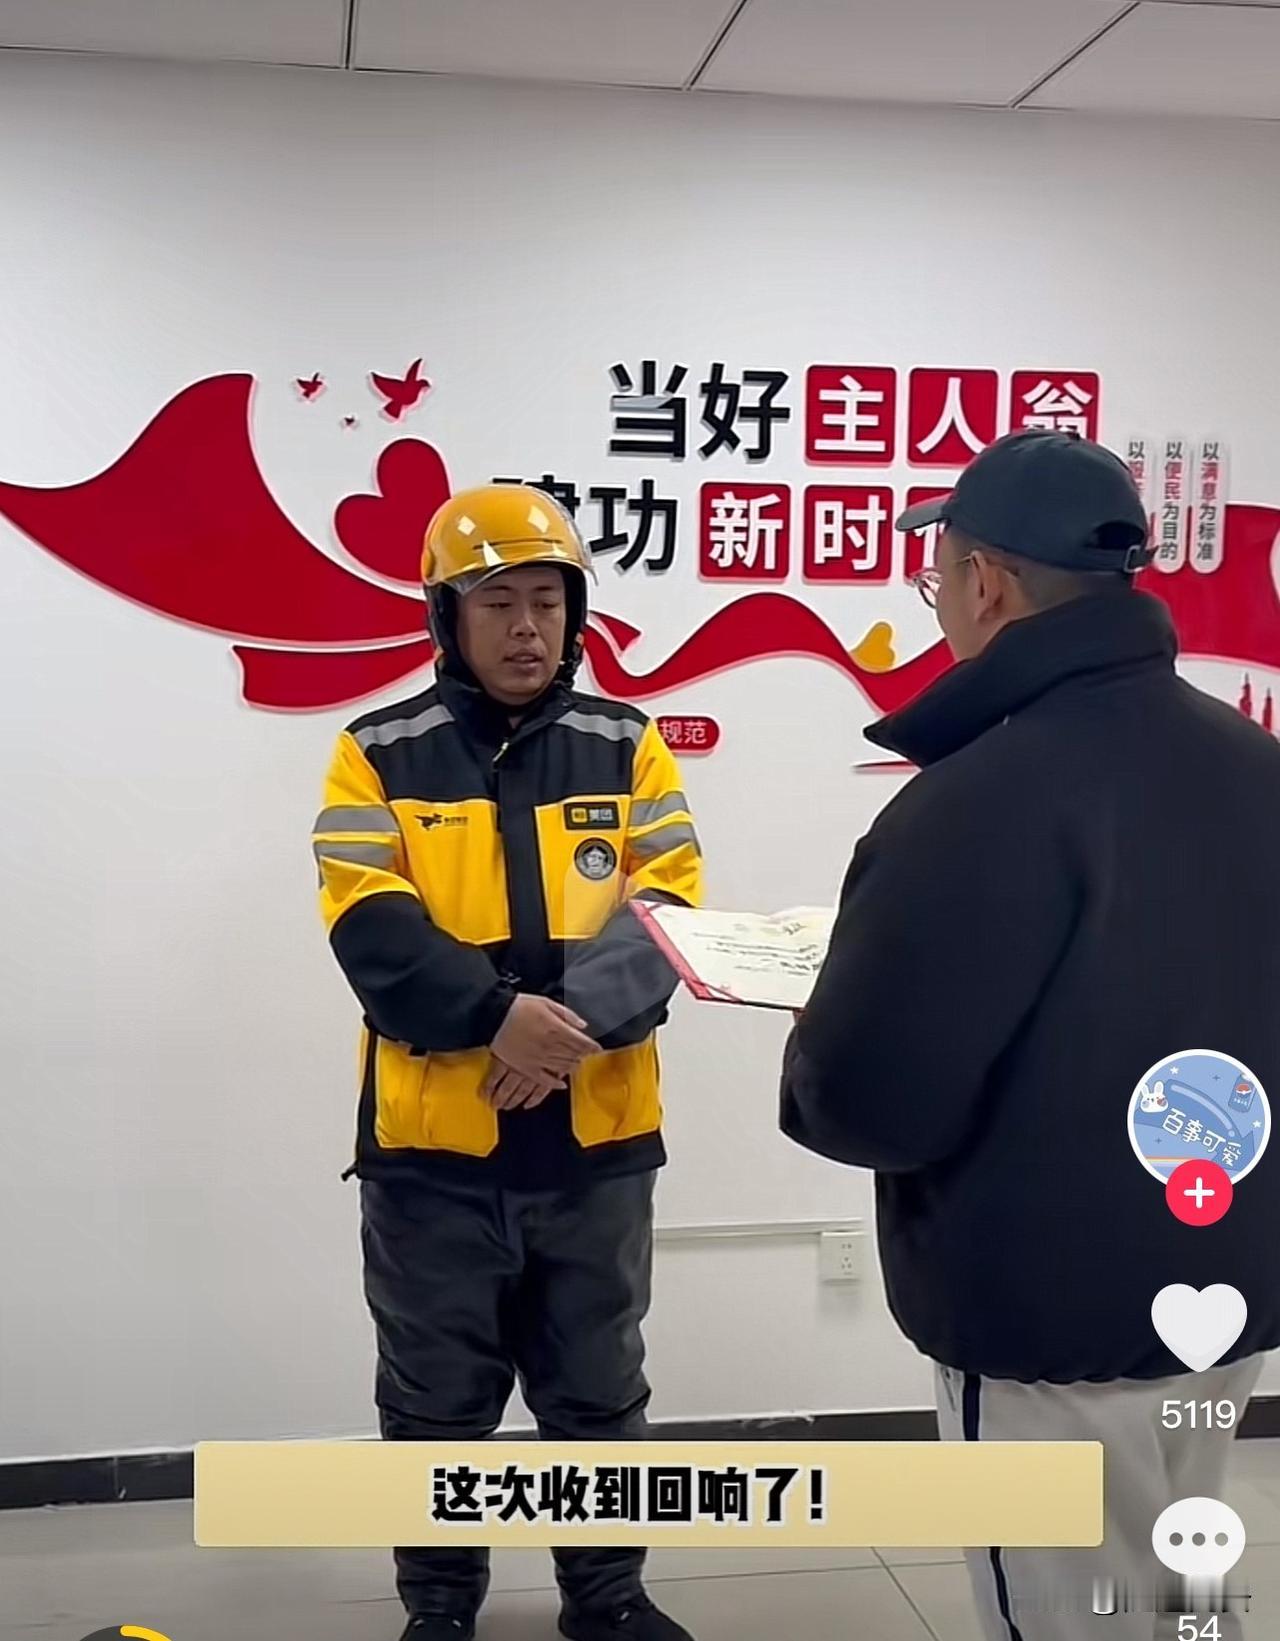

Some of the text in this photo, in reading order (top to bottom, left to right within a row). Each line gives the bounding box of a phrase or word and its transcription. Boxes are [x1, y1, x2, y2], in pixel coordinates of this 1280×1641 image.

[608, 360, 1095, 459] 当好主人翁
[492, 474, 946, 573] 功新时
[1159, 441, 1183, 561] 以便民为目的
[1196, 441, 1219, 560] 以满意为标准
